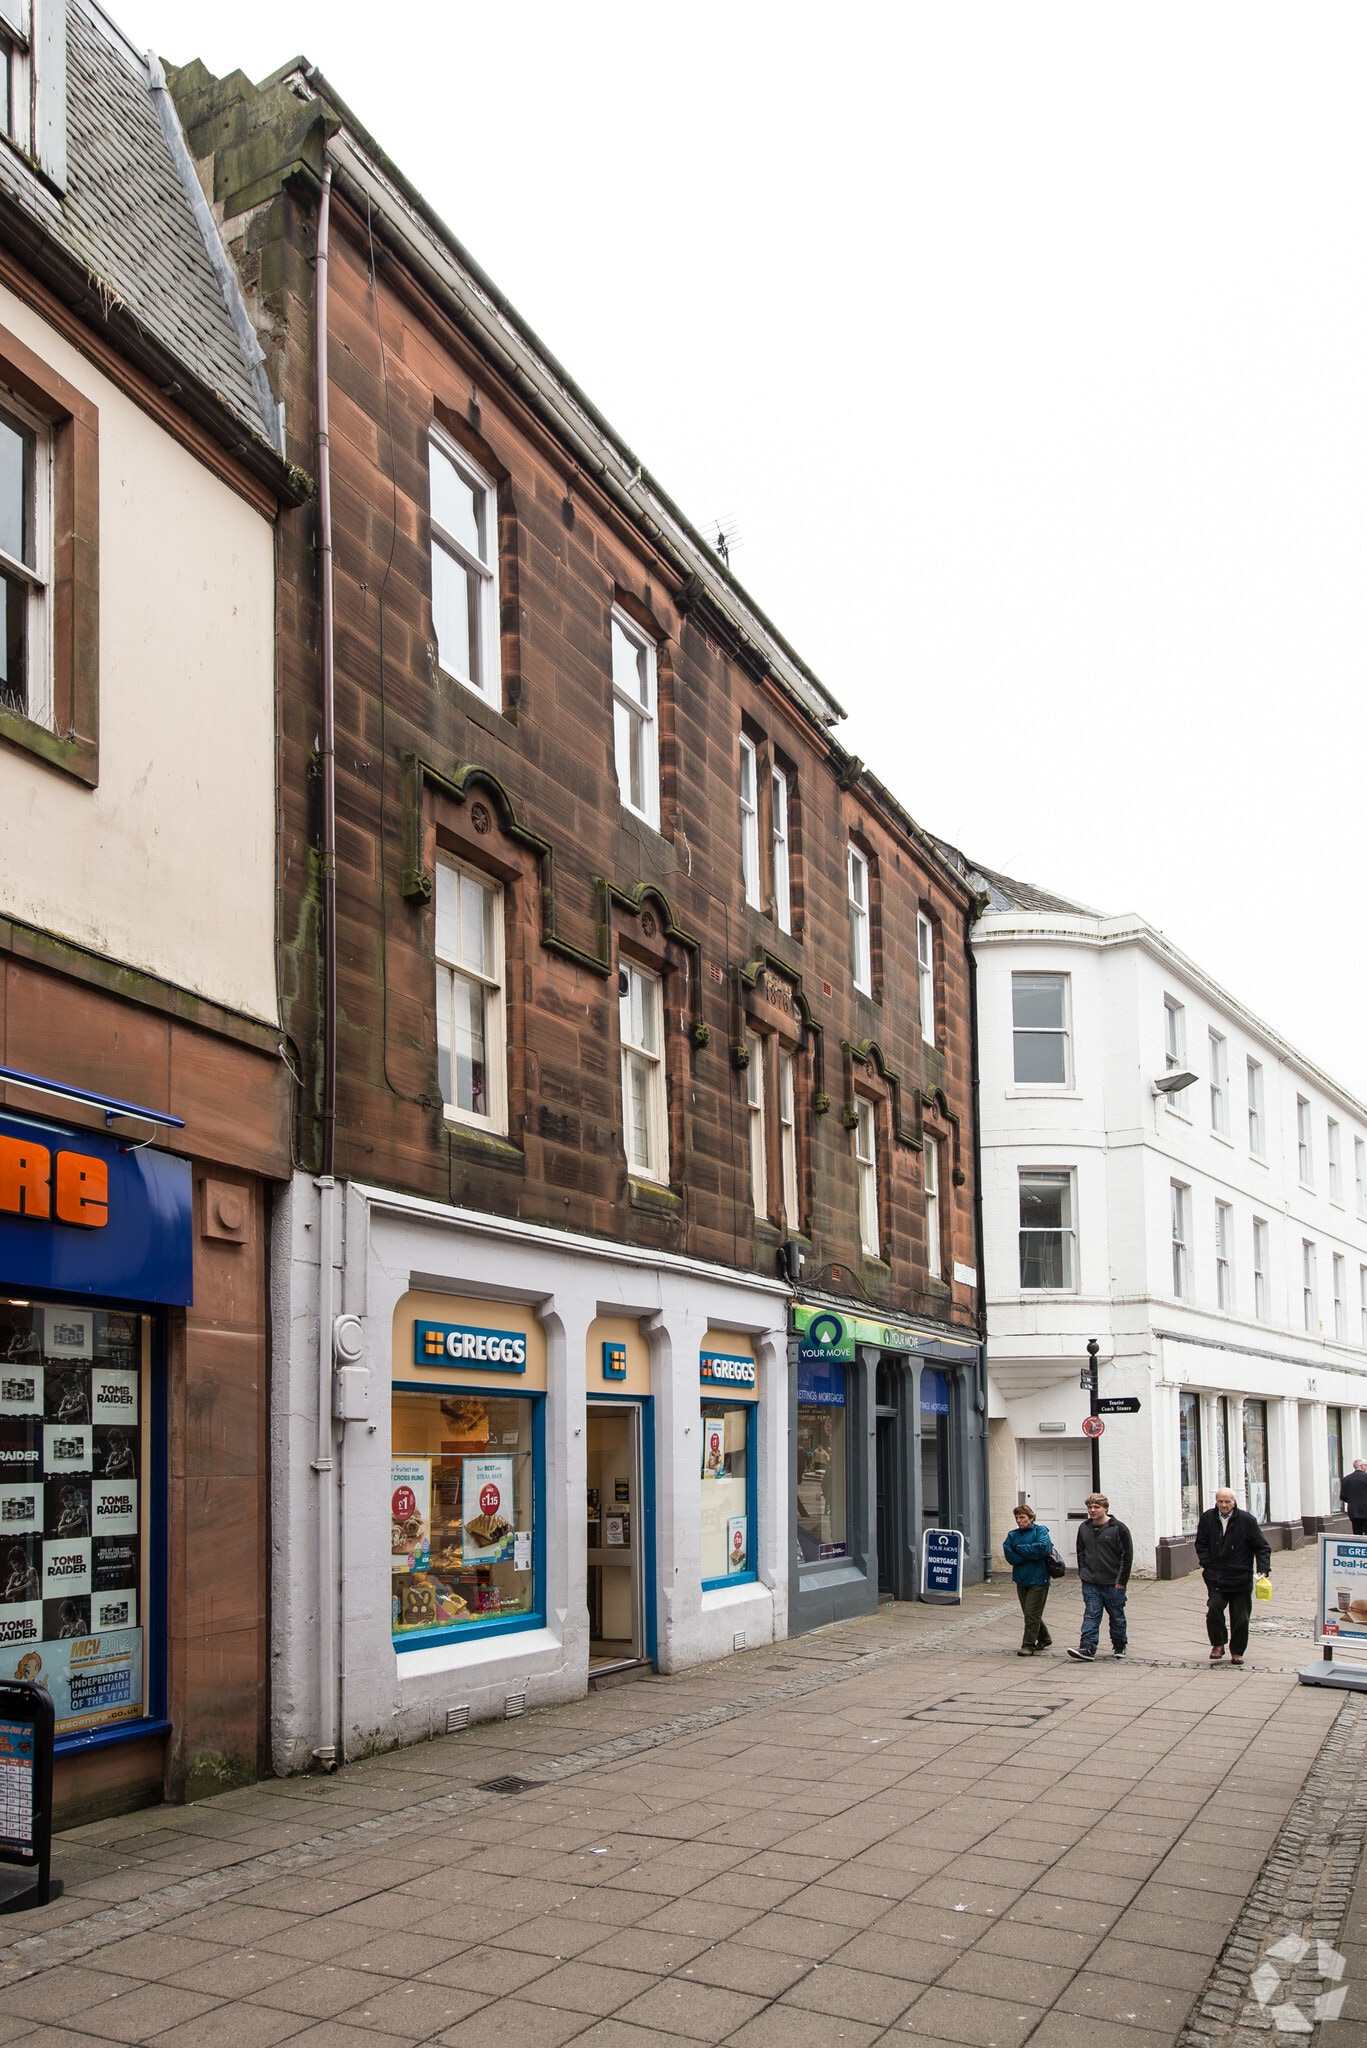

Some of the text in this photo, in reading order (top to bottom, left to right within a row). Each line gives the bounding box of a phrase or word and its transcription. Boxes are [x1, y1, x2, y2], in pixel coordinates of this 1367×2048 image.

[766, 981, 789, 1012] 1876
[890, 1332, 919, 1348] YOUR MOVE
[446, 1332, 525, 1364] GREGGS
[802, 1348, 851, 1358] YOUR MOVE
[712, 1359, 754, 1381] GREGGS
[101, 1385, 130, 1395] TOMB
[96, 1394, 133, 1404] RAIDER
[818, 1391, 845, 1403] MORTGAGES
[0, 1450, 39, 1460] RAIDER
[101, 1495, 130, 1506] TOMB
[398, 1497, 408, 1510] £1
[481, 1493, 498, 1506] £1.15
[96, 1504, 133, 1515] RAIDER
[1348, 1547, 1367, 1556] GRE
[51, 1555, 83, 1566] TOMB
[928, 1557, 957, 1565] MORTGAGE
[47, 1564, 87, 1576] RAIDER
[933, 1566, 952, 1574] ADVICE
[0, 1618, 34, 1632] TOMB
[71, 1671, 130, 1689] INDEPENDENT
[72, 1680, 130, 1699] GAMES RETAILER
[72, 1690, 129, 1709] OF THE YEAR
